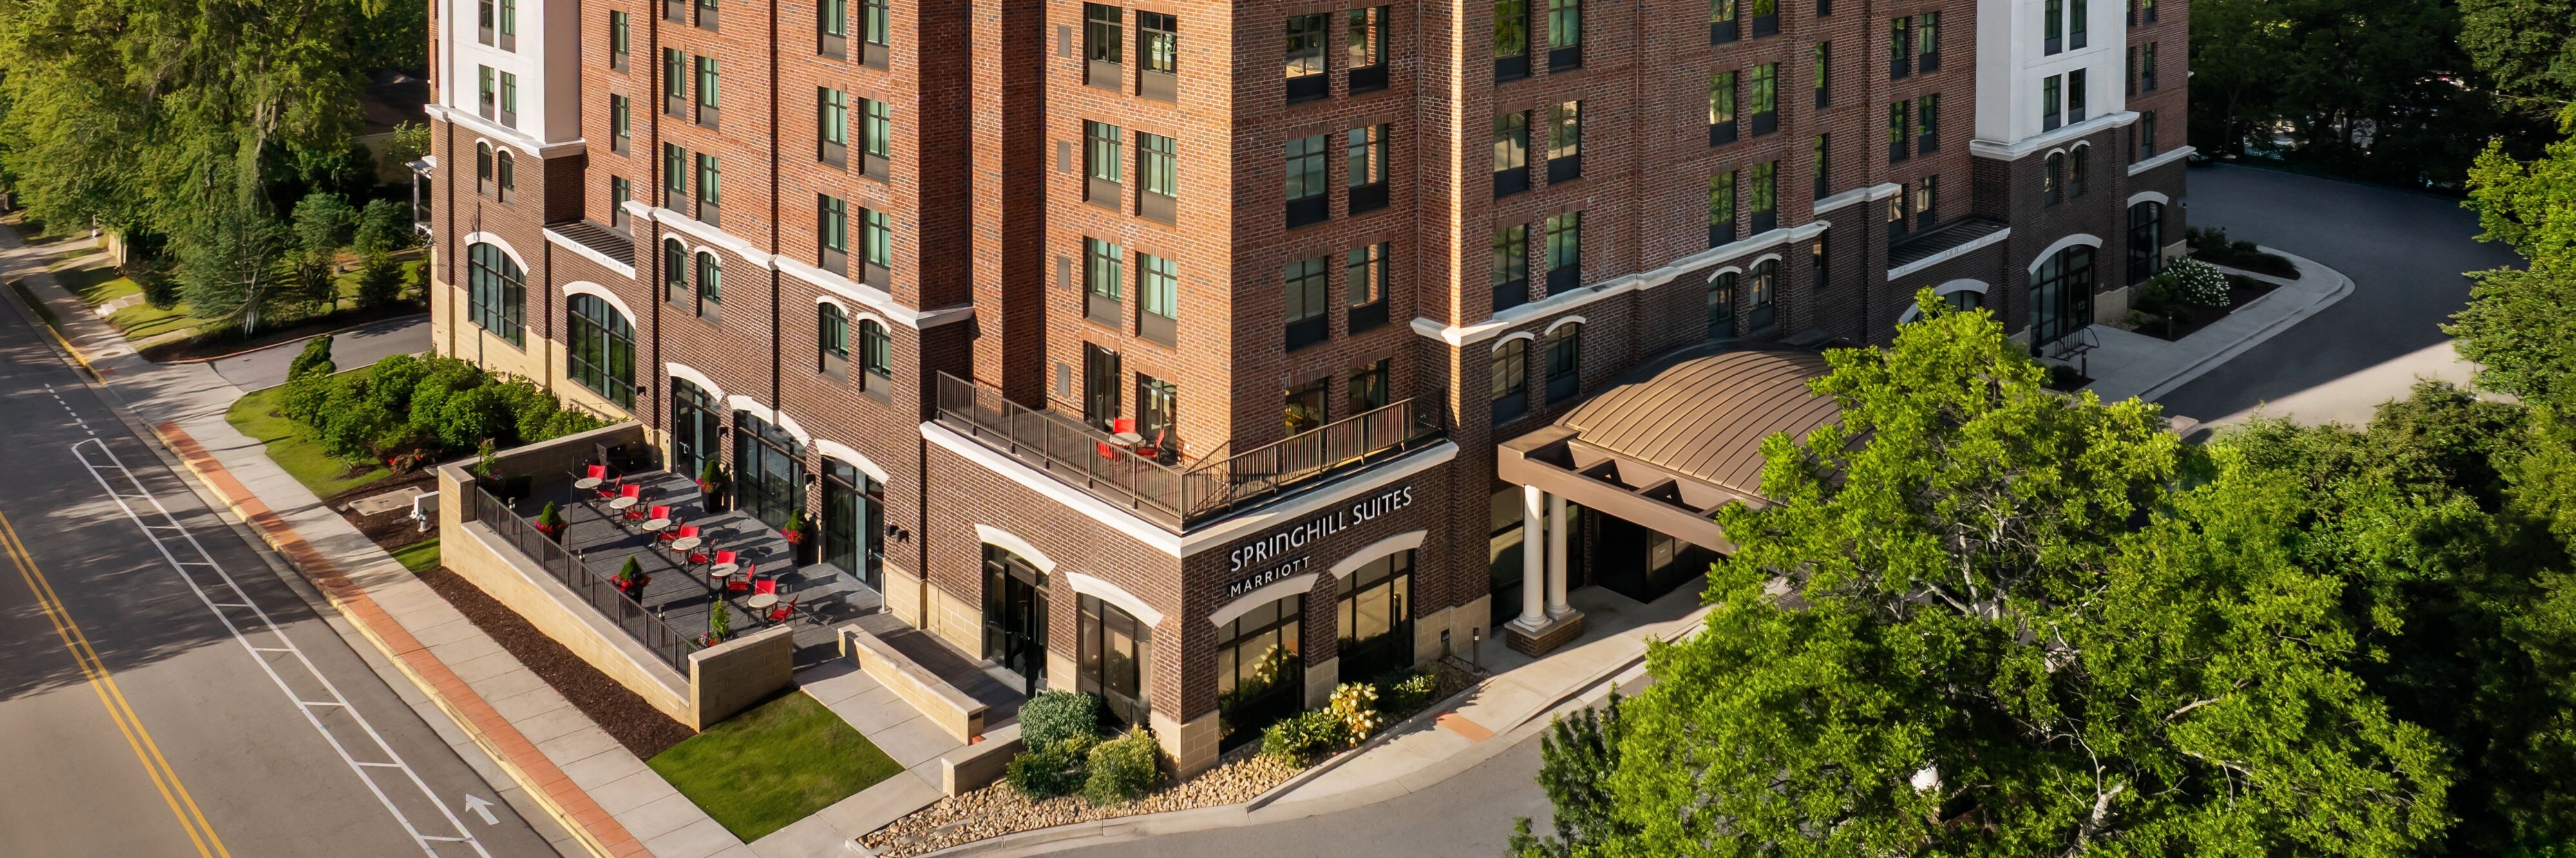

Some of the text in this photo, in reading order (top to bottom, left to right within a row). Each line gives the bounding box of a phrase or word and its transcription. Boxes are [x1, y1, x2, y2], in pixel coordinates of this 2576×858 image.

[1231, 486, 1412, 571] SPRINGHILL SUITES
[1231, 556, 1310, 597] MARRIOTT
